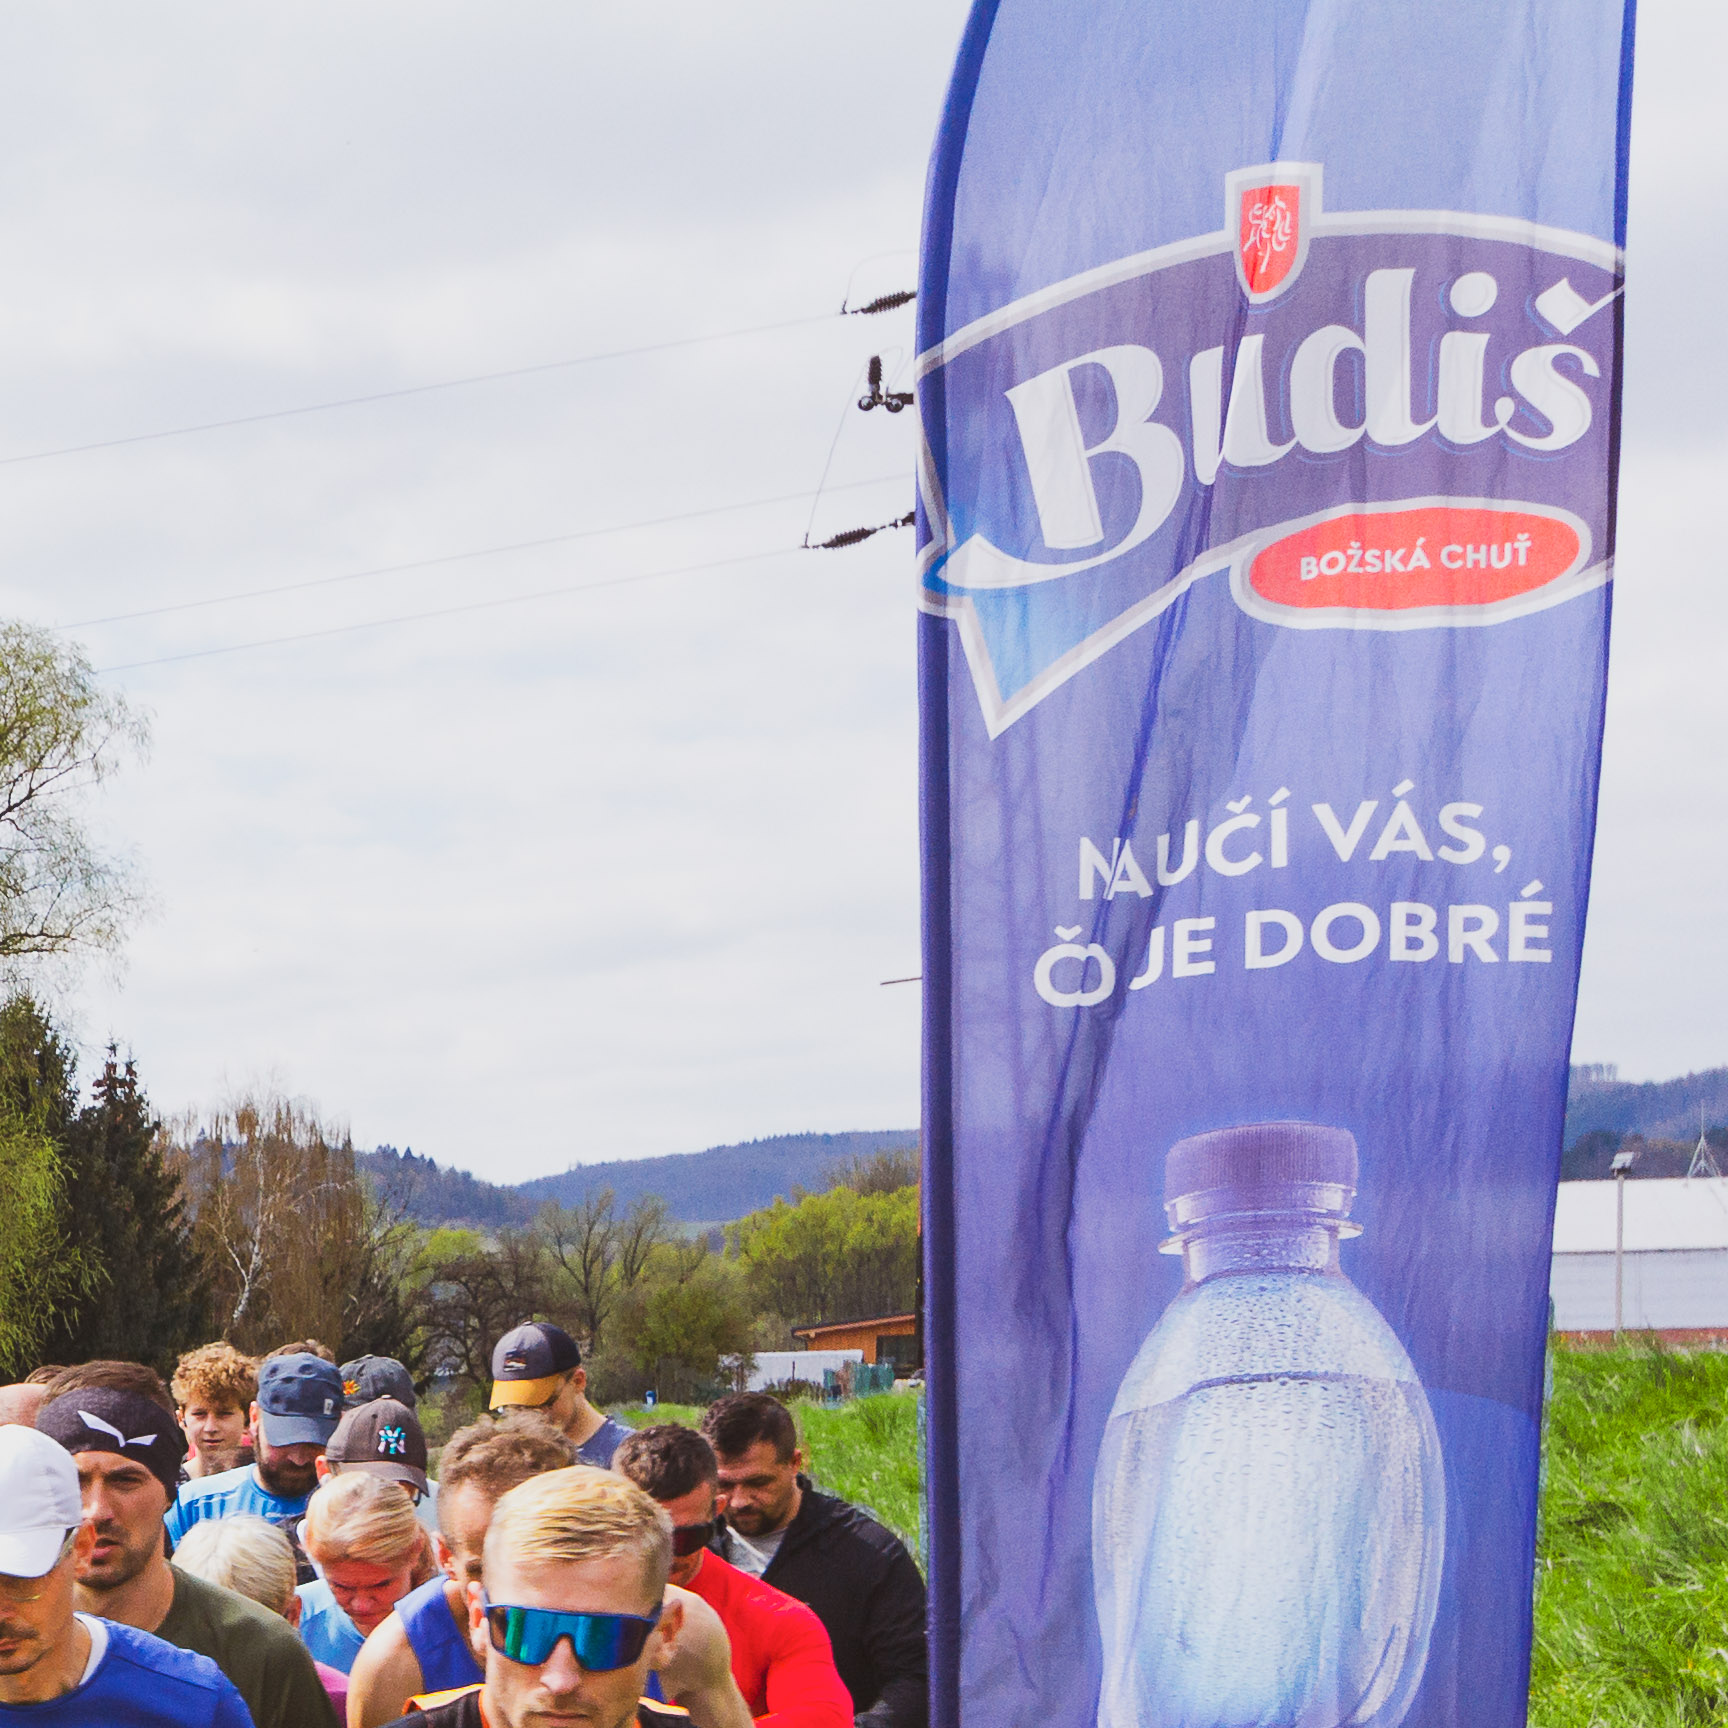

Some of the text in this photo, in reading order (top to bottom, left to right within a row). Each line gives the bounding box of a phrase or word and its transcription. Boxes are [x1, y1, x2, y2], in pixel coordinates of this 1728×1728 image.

[938, 268, 1625, 588] Budiš
[1299, 534, 1533, 581] BOŽSKÁ CHUŤ
[1078, 779, 1512, 900] NAUČÍ VÁS,
[1128, 916, 1216, 991] JE
[1245, 880, 1554, 970] DOBRÉ
